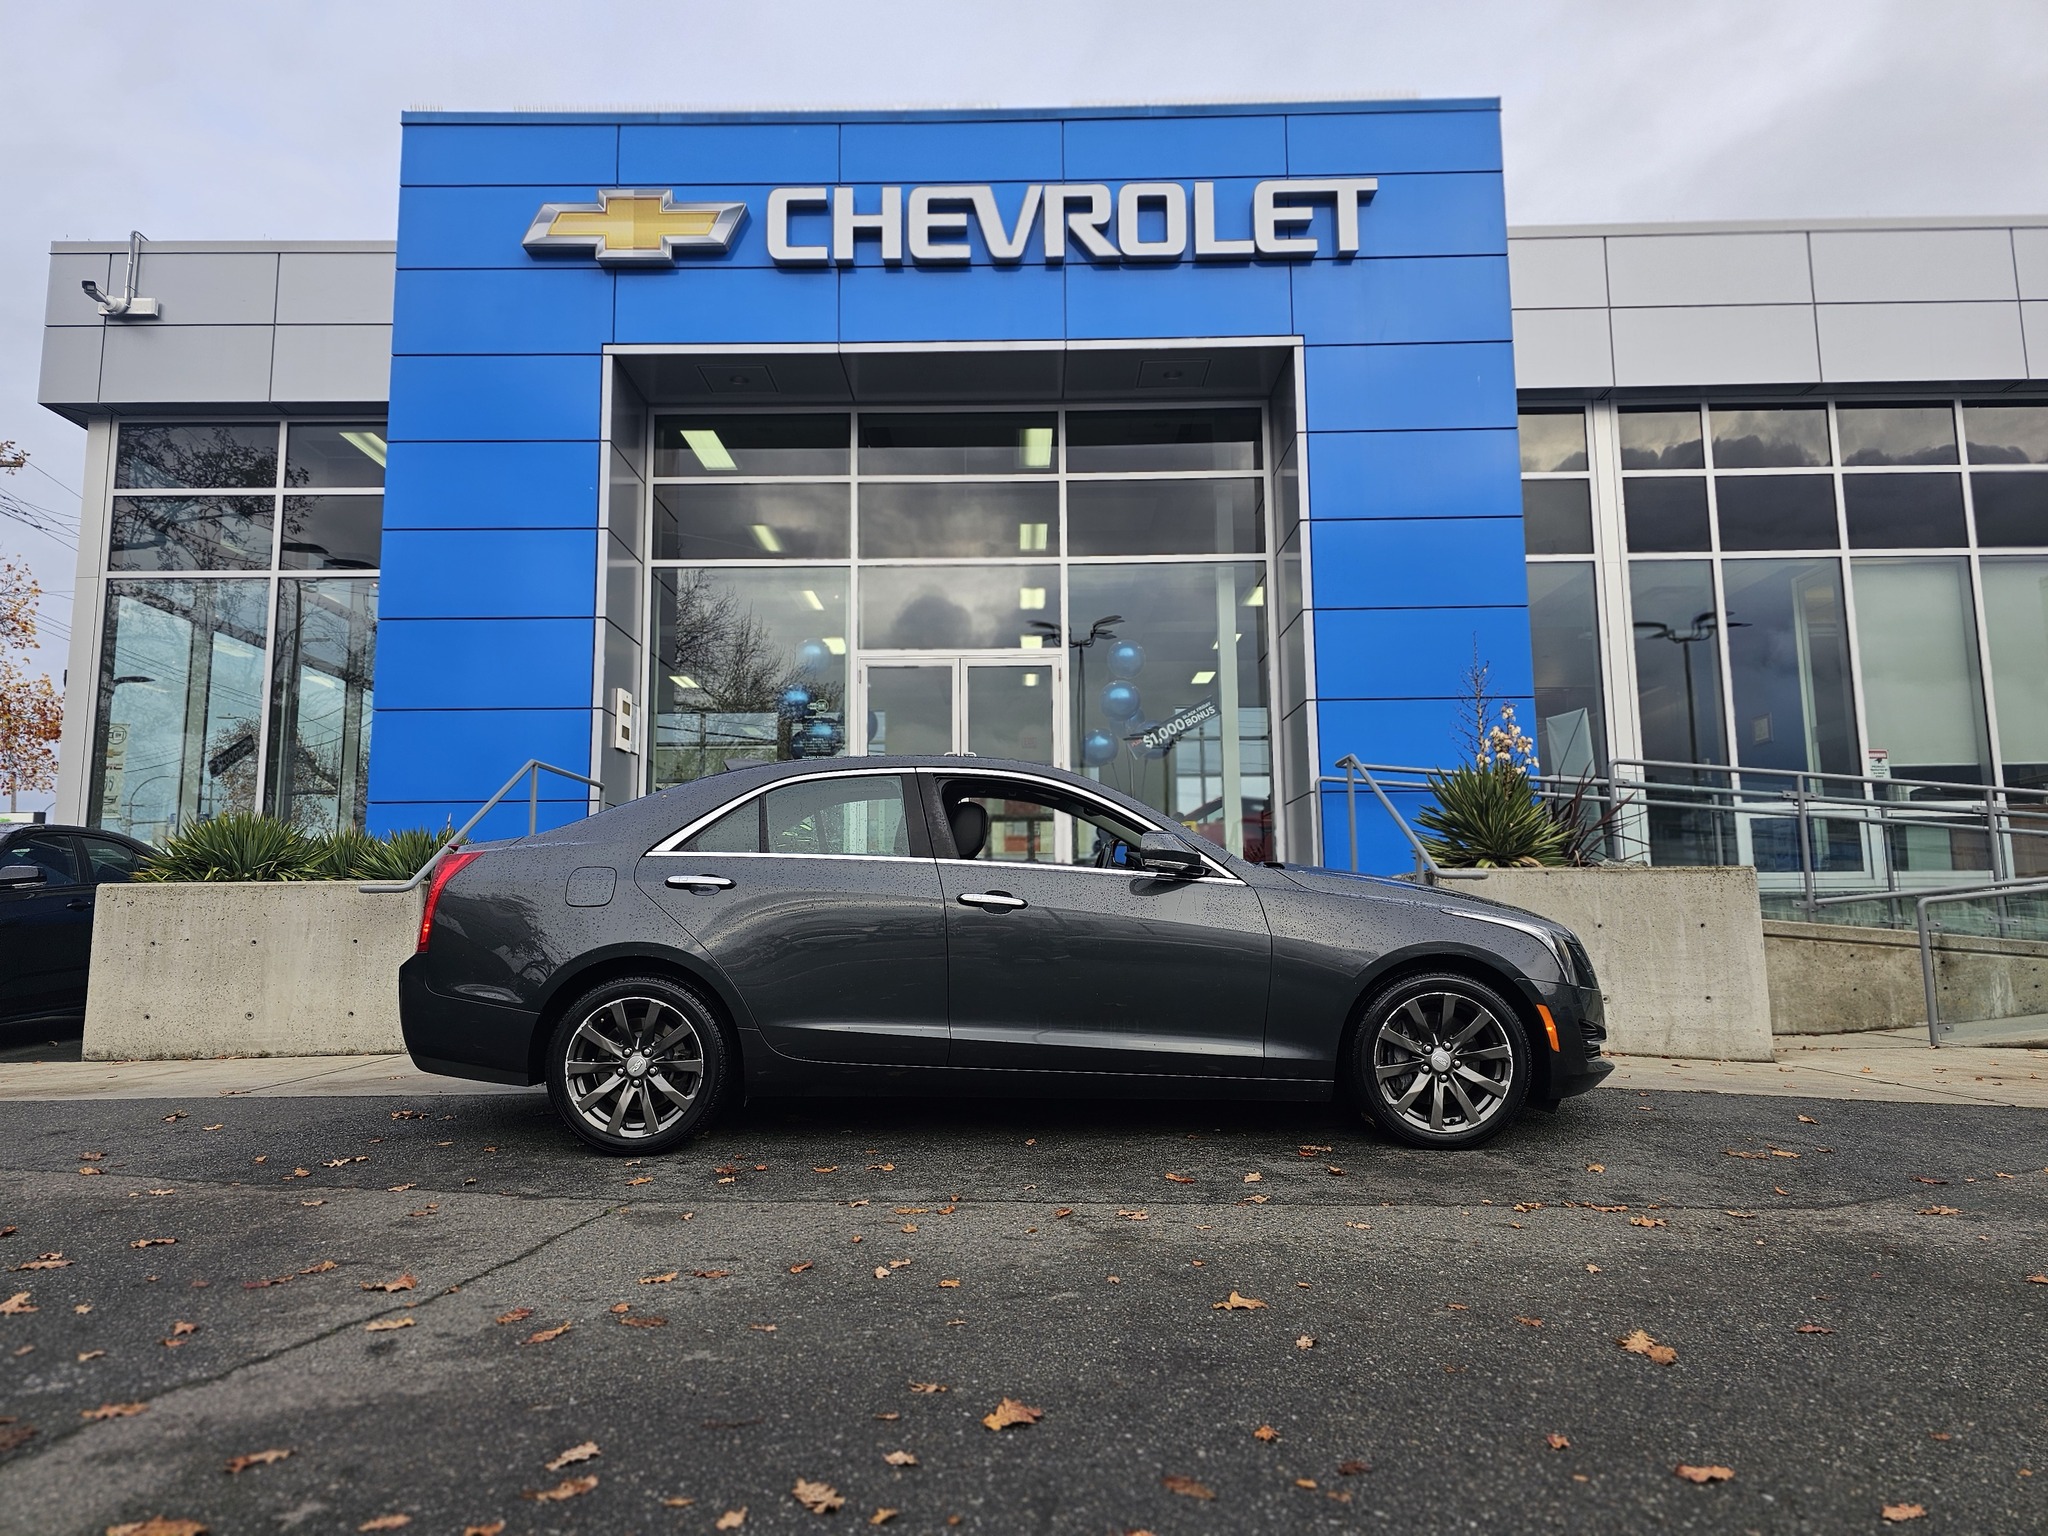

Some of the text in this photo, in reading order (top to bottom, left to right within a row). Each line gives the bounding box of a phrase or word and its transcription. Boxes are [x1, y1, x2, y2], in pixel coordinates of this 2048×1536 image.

[766, 177, 1378, 267] CHEVROLET
[1143, 718, 1186, 749] $1,000
[1184, 706, 1216, 727] BONUS
[1182, 710, 1196, 720] BLACK
